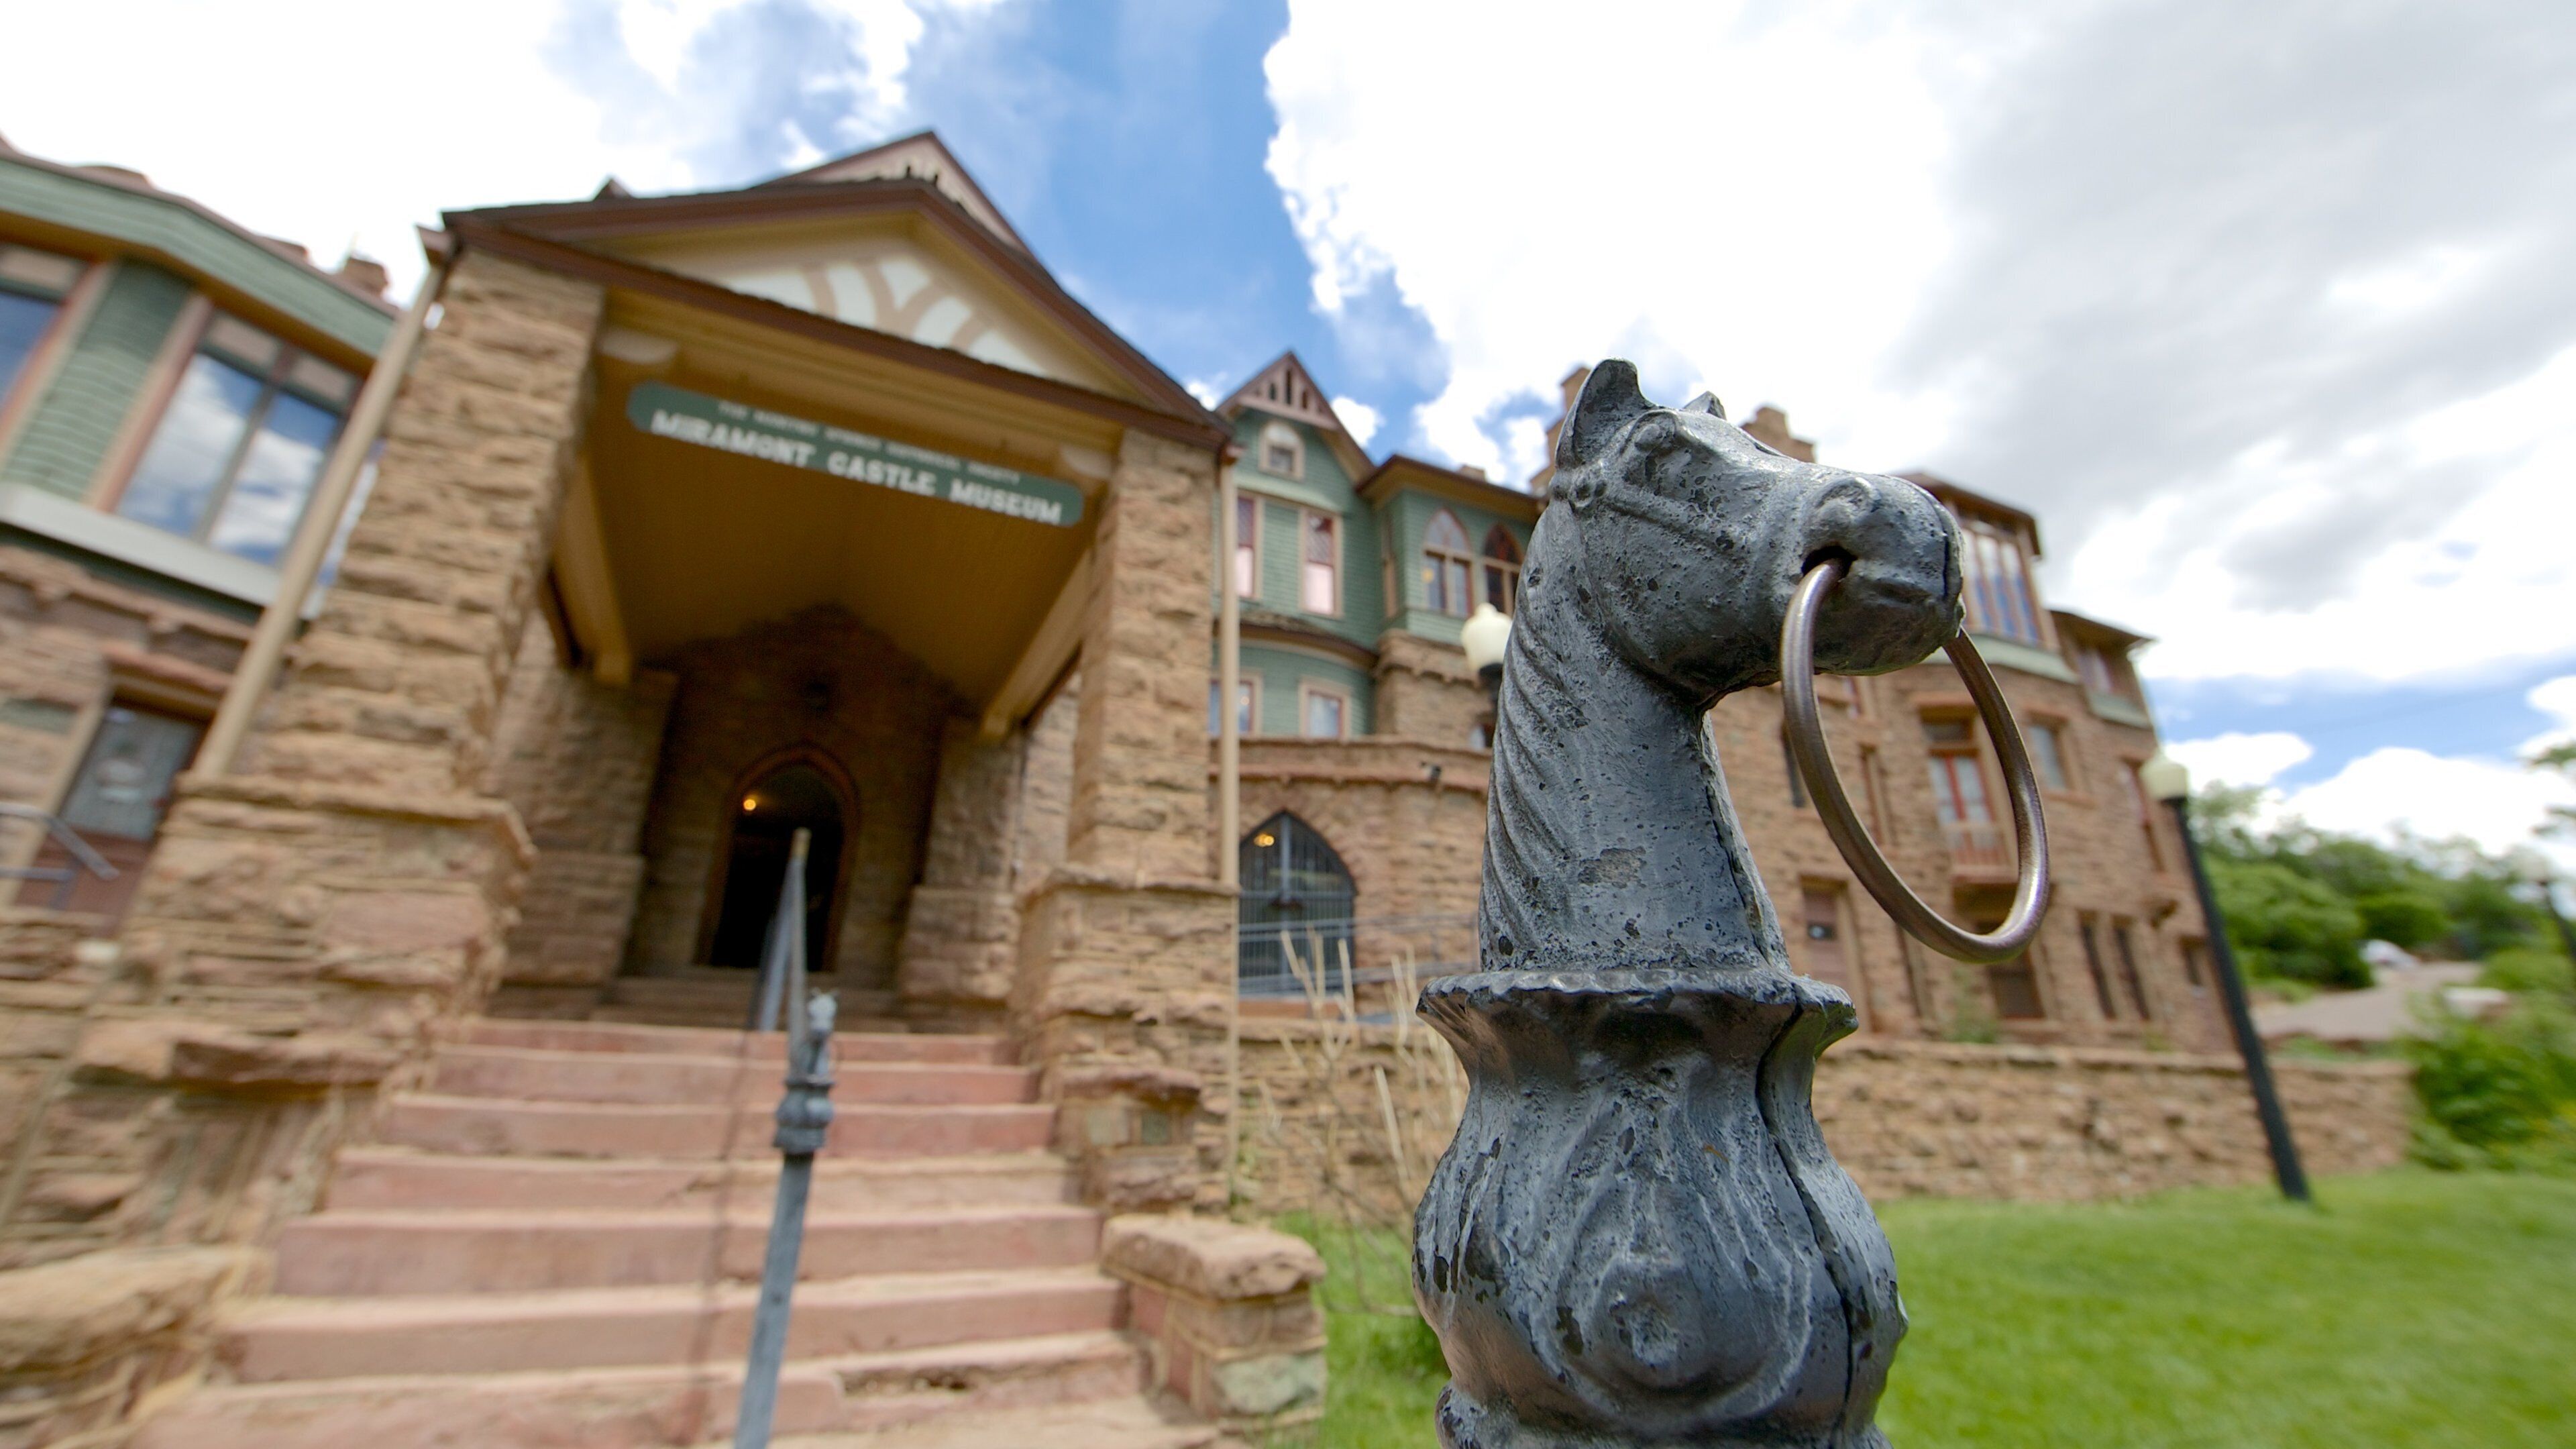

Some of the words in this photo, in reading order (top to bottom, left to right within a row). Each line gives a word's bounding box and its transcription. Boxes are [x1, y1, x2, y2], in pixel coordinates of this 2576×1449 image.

[651, 409, 816, 468] MIRAMONT
[827, 451, 937, 496] CASTLE
[949, 477, 1062, 525] MUSEUM
